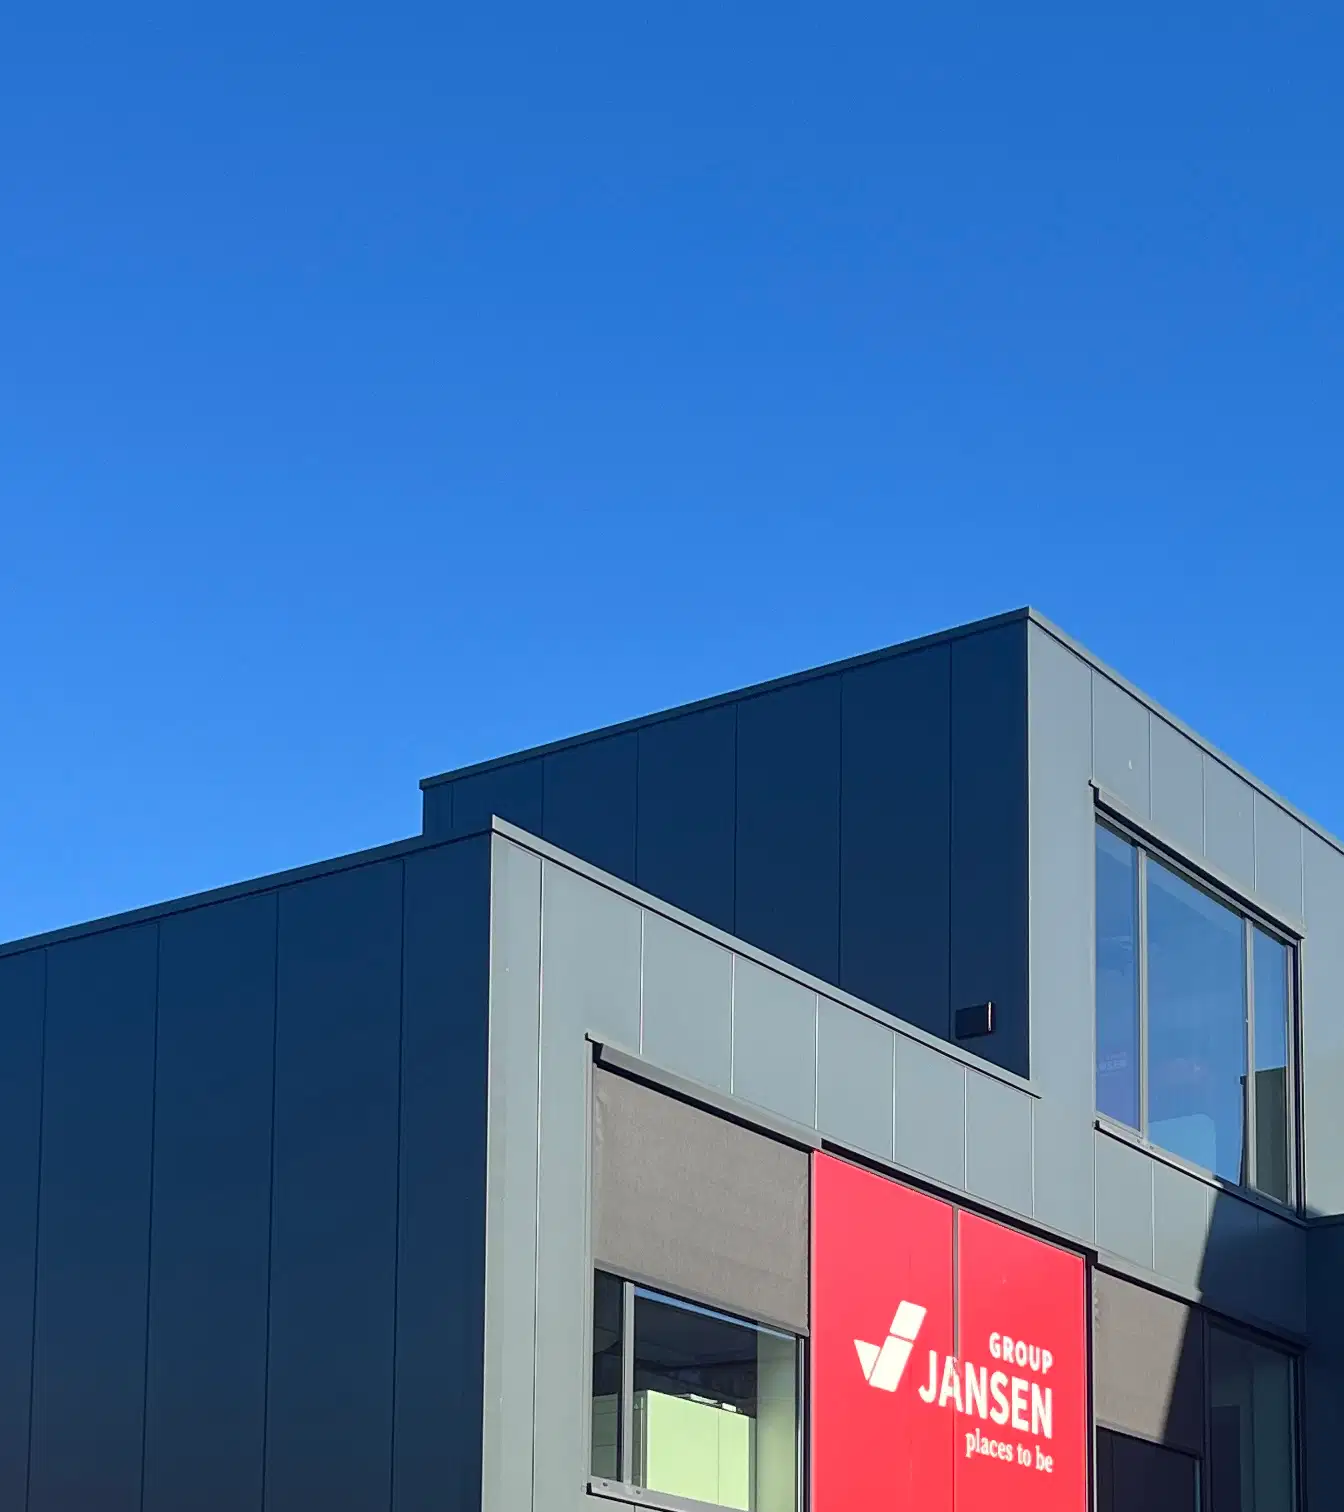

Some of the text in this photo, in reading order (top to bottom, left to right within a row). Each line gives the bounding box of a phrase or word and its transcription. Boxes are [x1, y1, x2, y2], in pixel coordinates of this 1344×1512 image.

[989, 1331, 1053, 1375] GROUP
[918, 1349, 1053, 1439] JANSEN
[965, 1427, 1054, 1473] places to be
